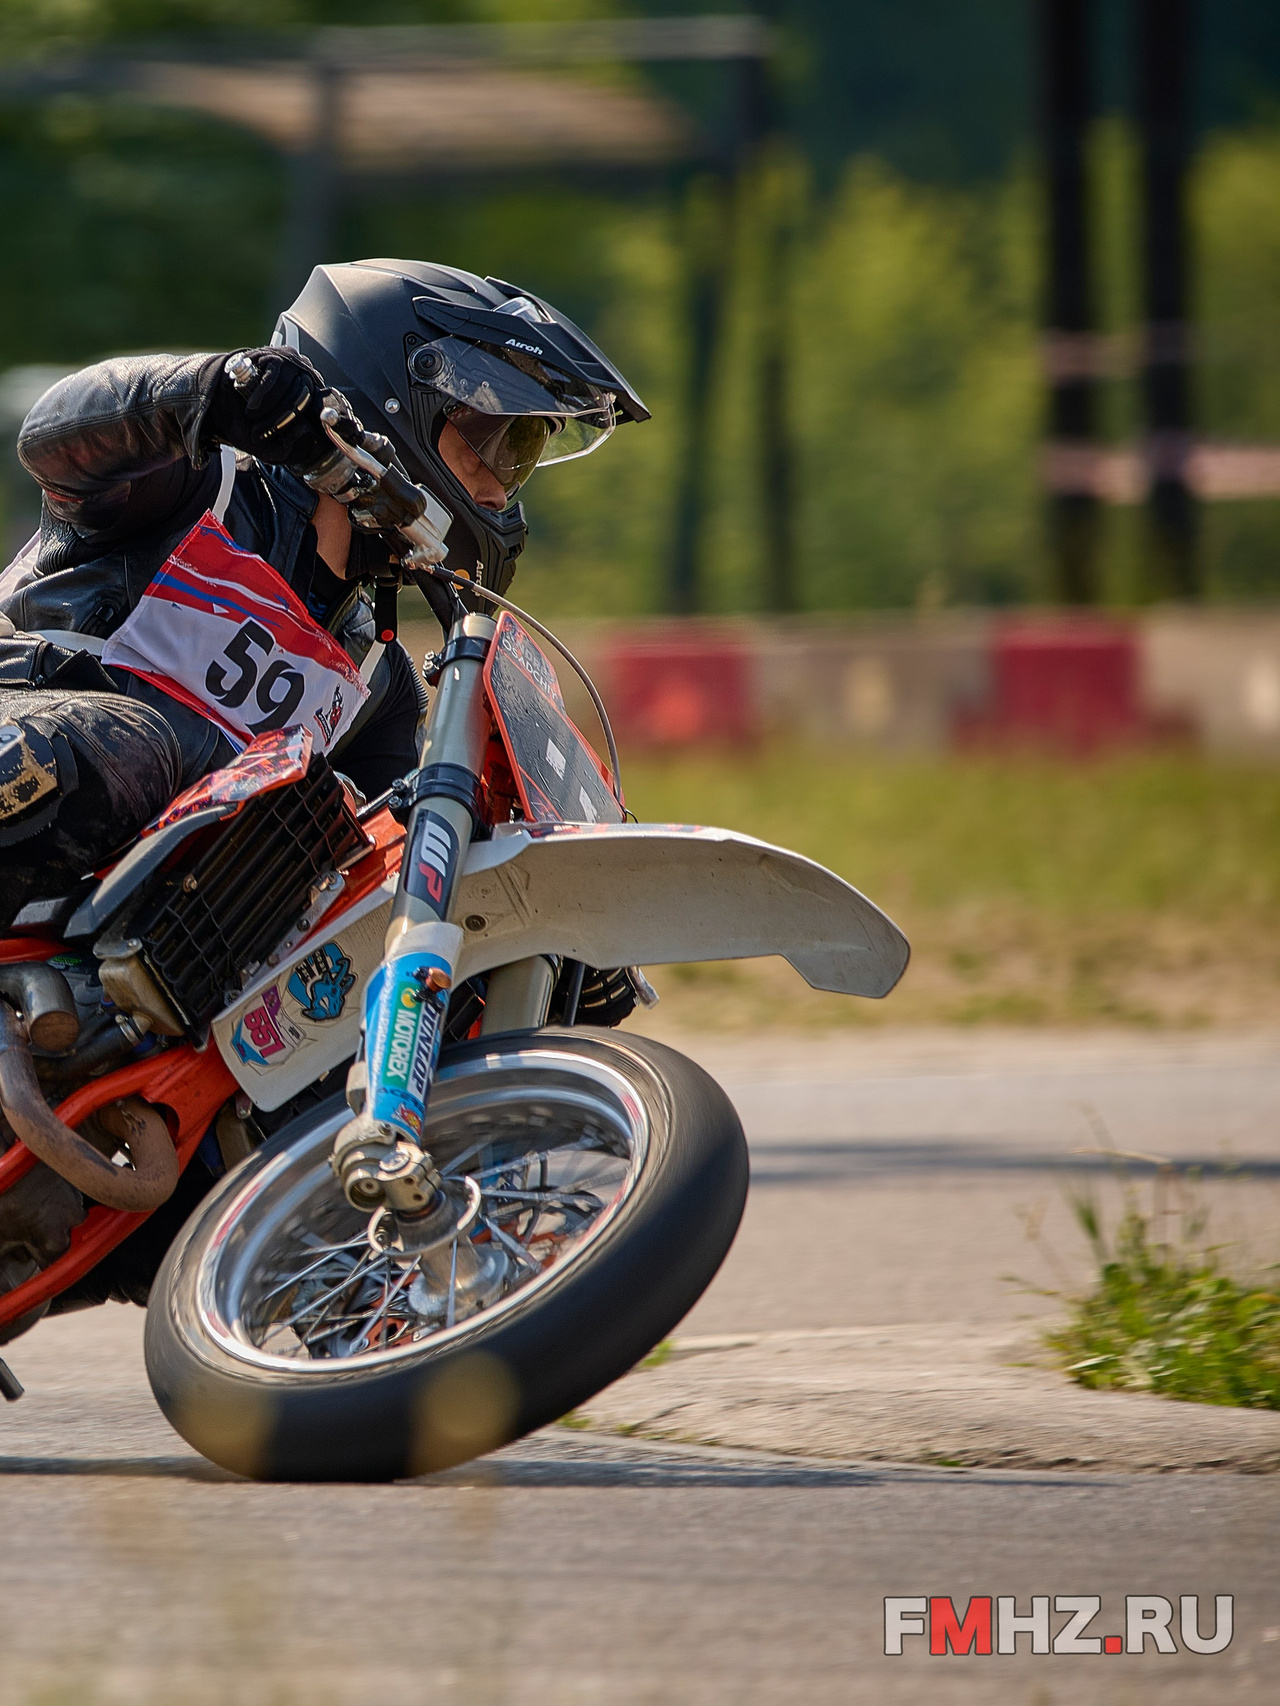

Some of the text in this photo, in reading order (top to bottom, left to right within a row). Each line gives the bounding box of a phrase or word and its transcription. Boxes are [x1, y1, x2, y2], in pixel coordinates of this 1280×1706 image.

[505, 338, 544, 356] Airoh
[205, 616, 305, 739] 59
[502, 639, 558, 699] OSADCHIY
[386, 1008, 418, 1081] MOTOREX
